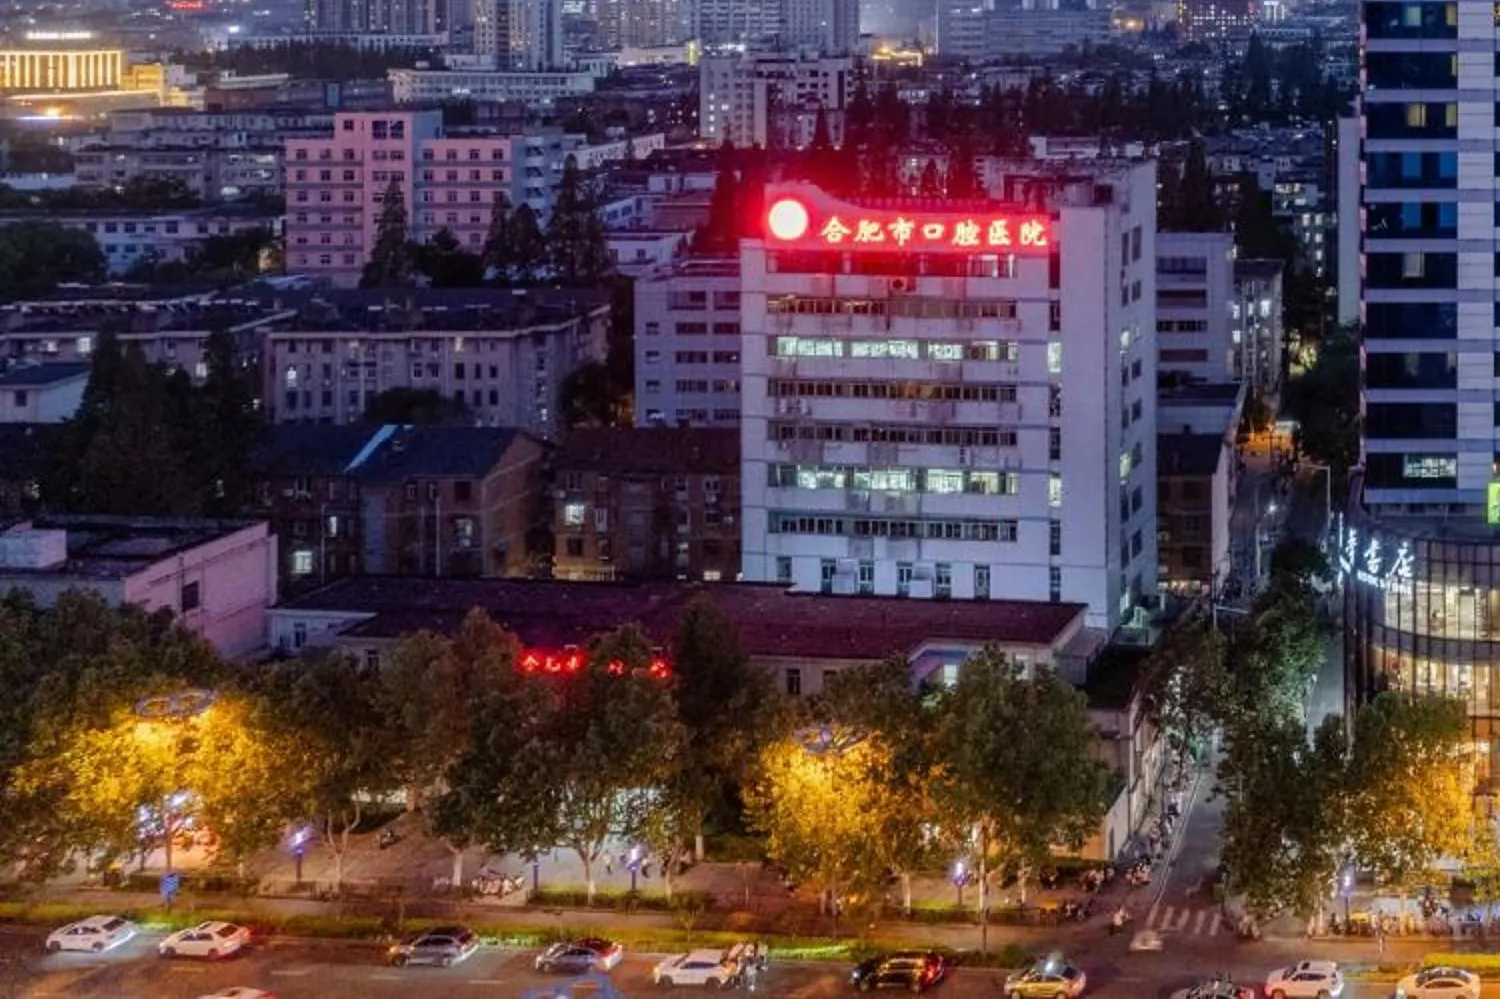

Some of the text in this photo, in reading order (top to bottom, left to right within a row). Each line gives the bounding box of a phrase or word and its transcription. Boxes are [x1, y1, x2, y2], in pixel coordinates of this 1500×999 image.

[821, 216, 1047, 246] 合肥市口腔医院
